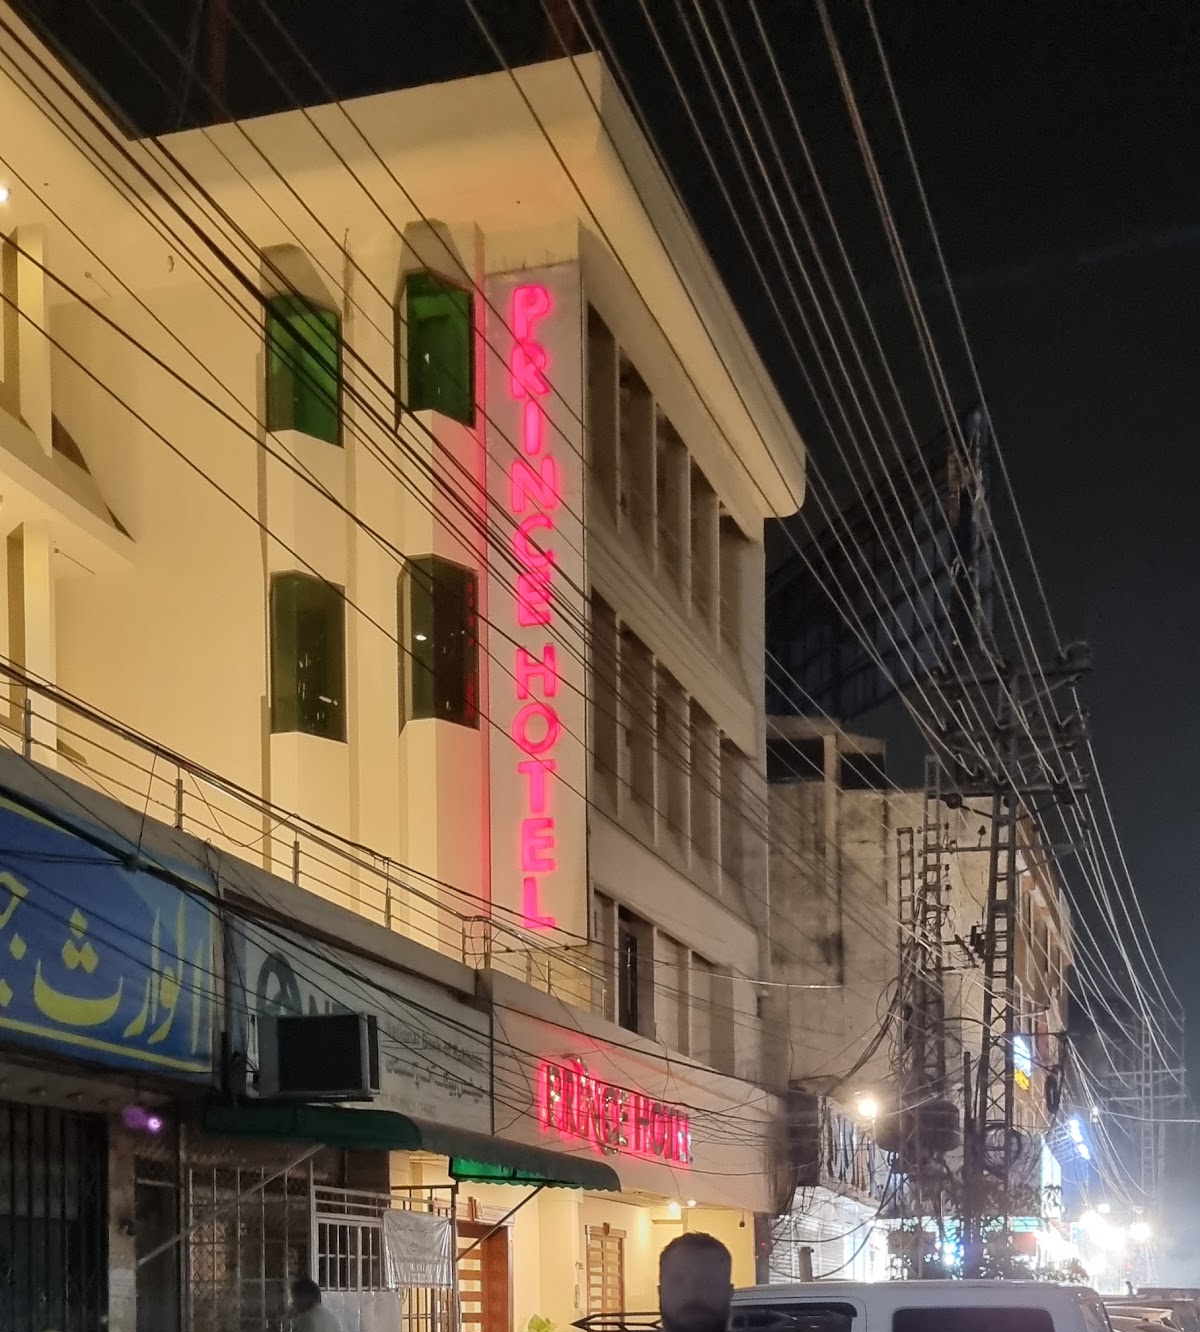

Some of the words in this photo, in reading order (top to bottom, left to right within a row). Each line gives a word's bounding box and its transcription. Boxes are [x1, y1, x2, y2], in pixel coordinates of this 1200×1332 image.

[511, 285, 558, 627] PRINCE
[512, 643, 560, 929] HOTEL
[34, 892, 206, 1056] الوارث
